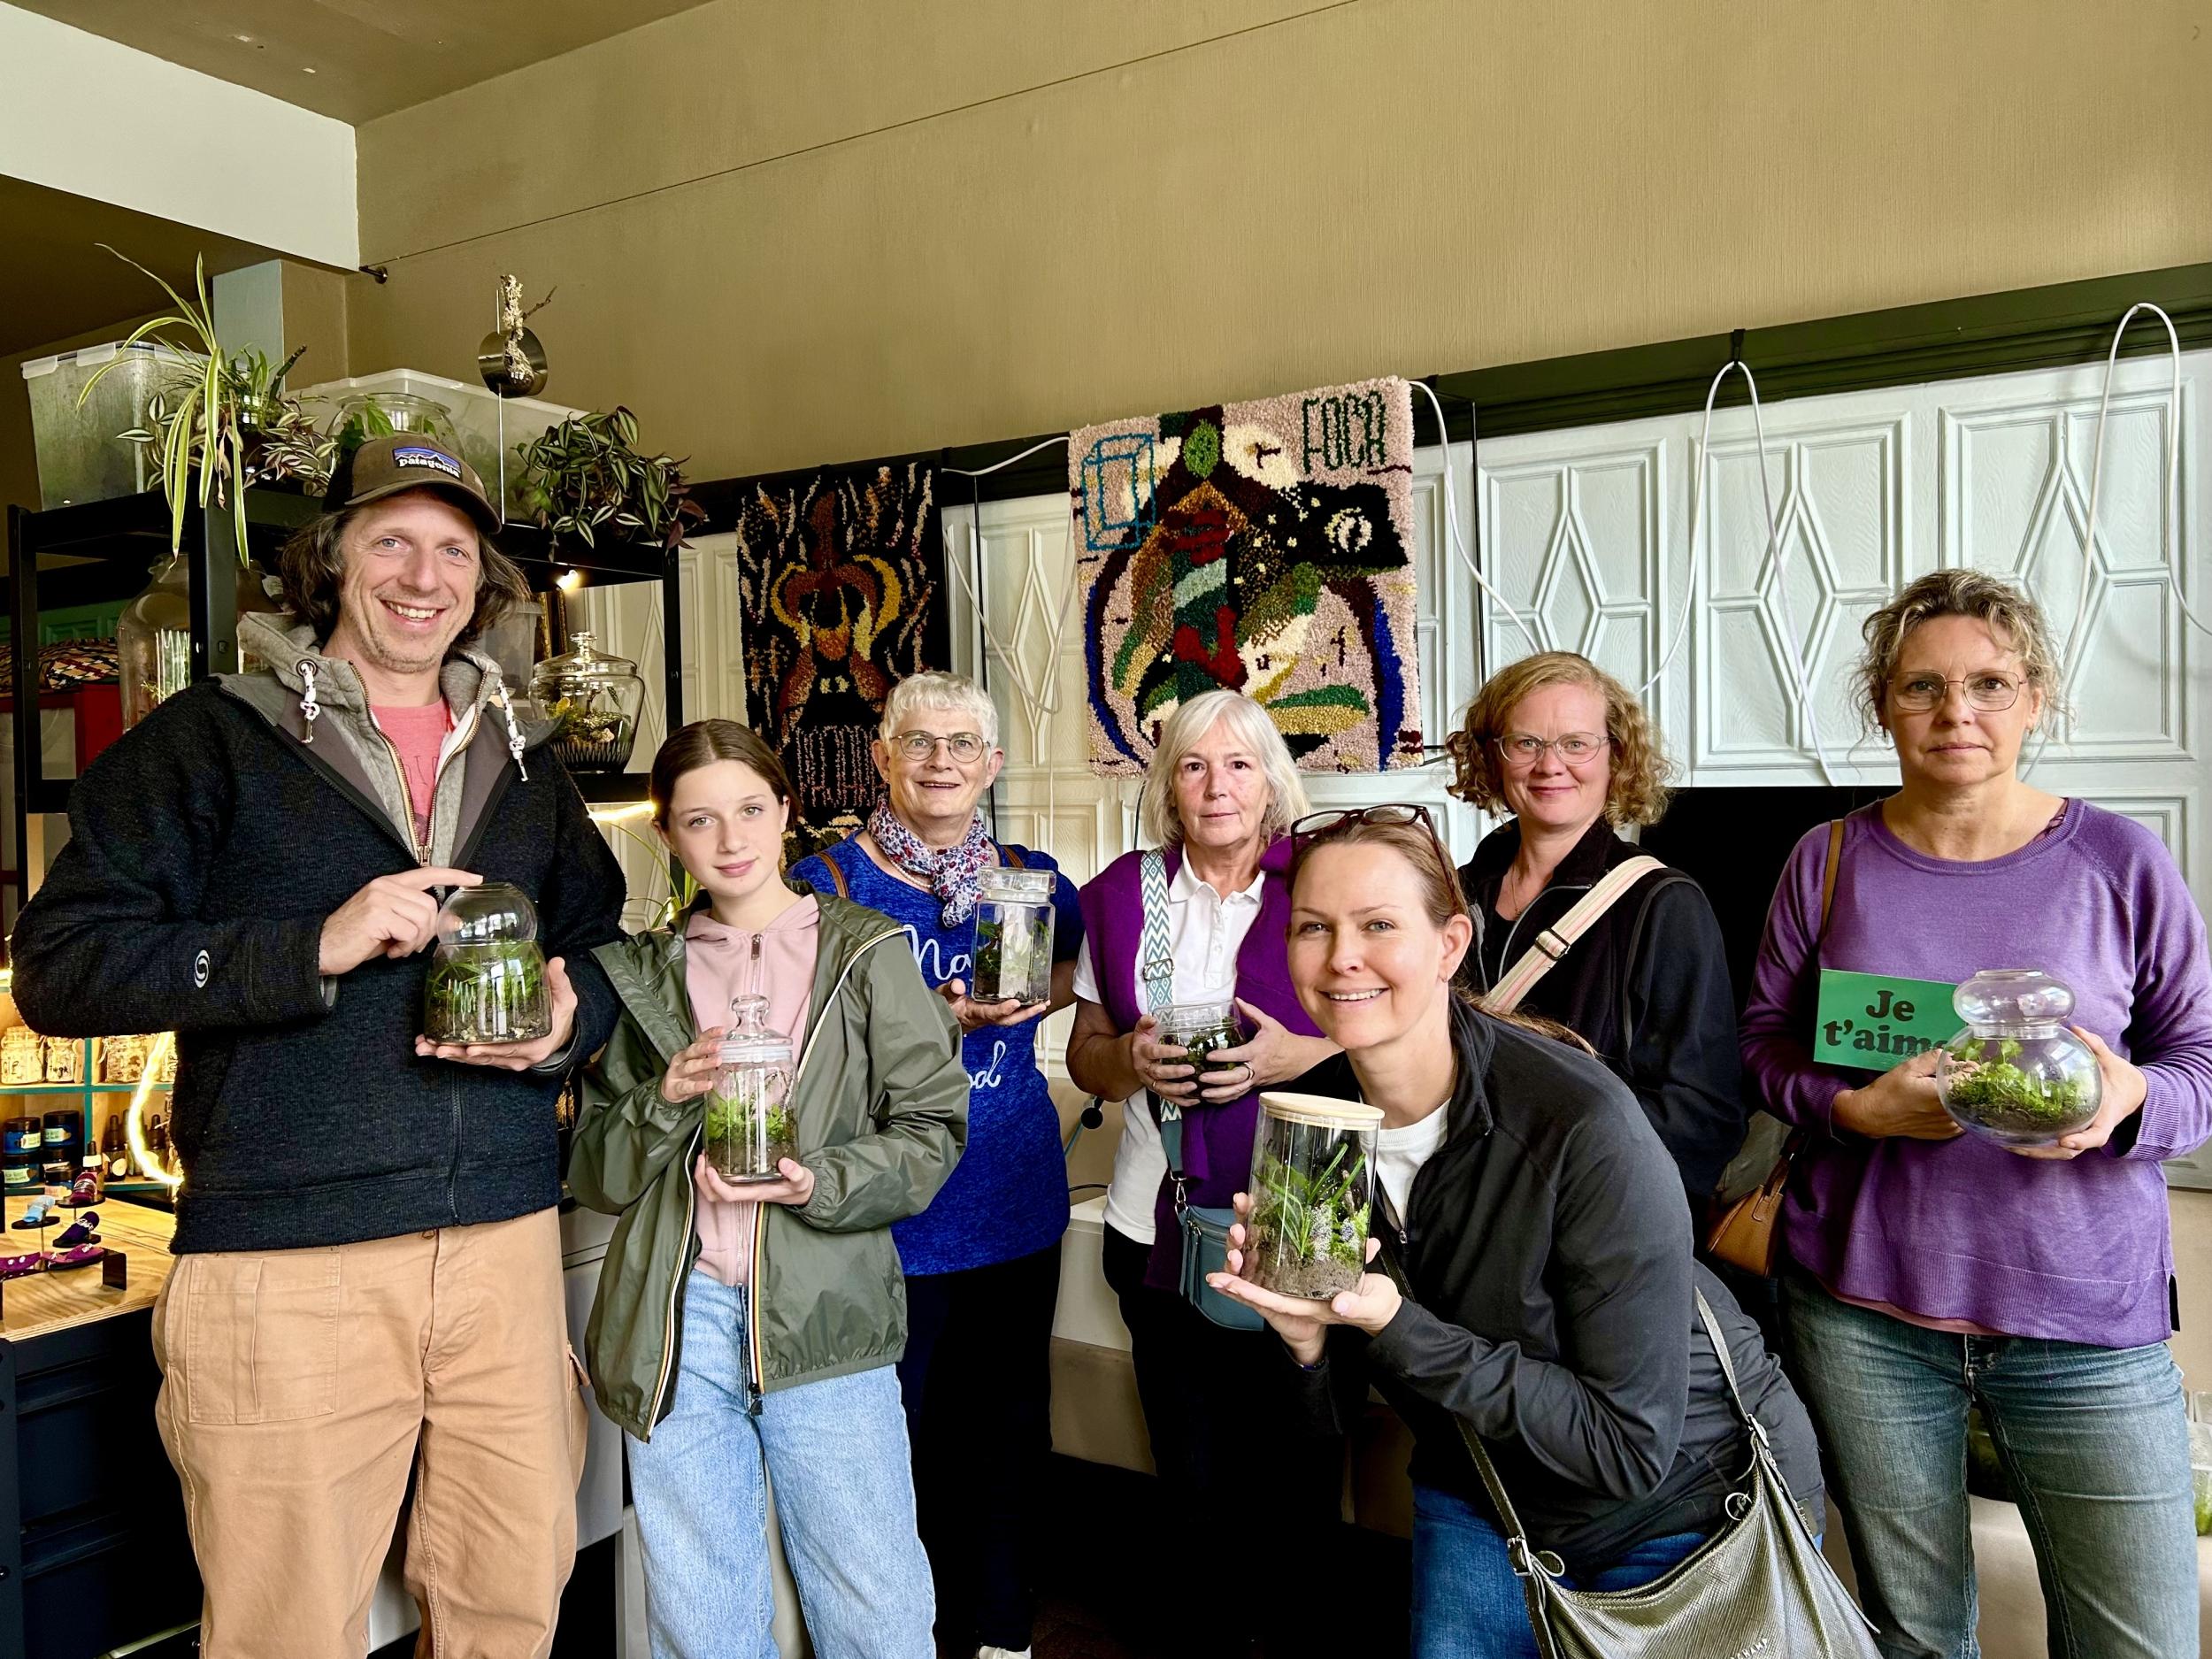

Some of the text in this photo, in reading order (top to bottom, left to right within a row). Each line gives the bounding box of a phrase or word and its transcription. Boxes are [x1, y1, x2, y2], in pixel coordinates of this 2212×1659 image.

[398, 457, 460, 479] patagonia
[902, 924, 972, 980] Na
[1865, 990, 1916, 1022] Je
[1730, 1638, 1768, 1659] CHAMP
